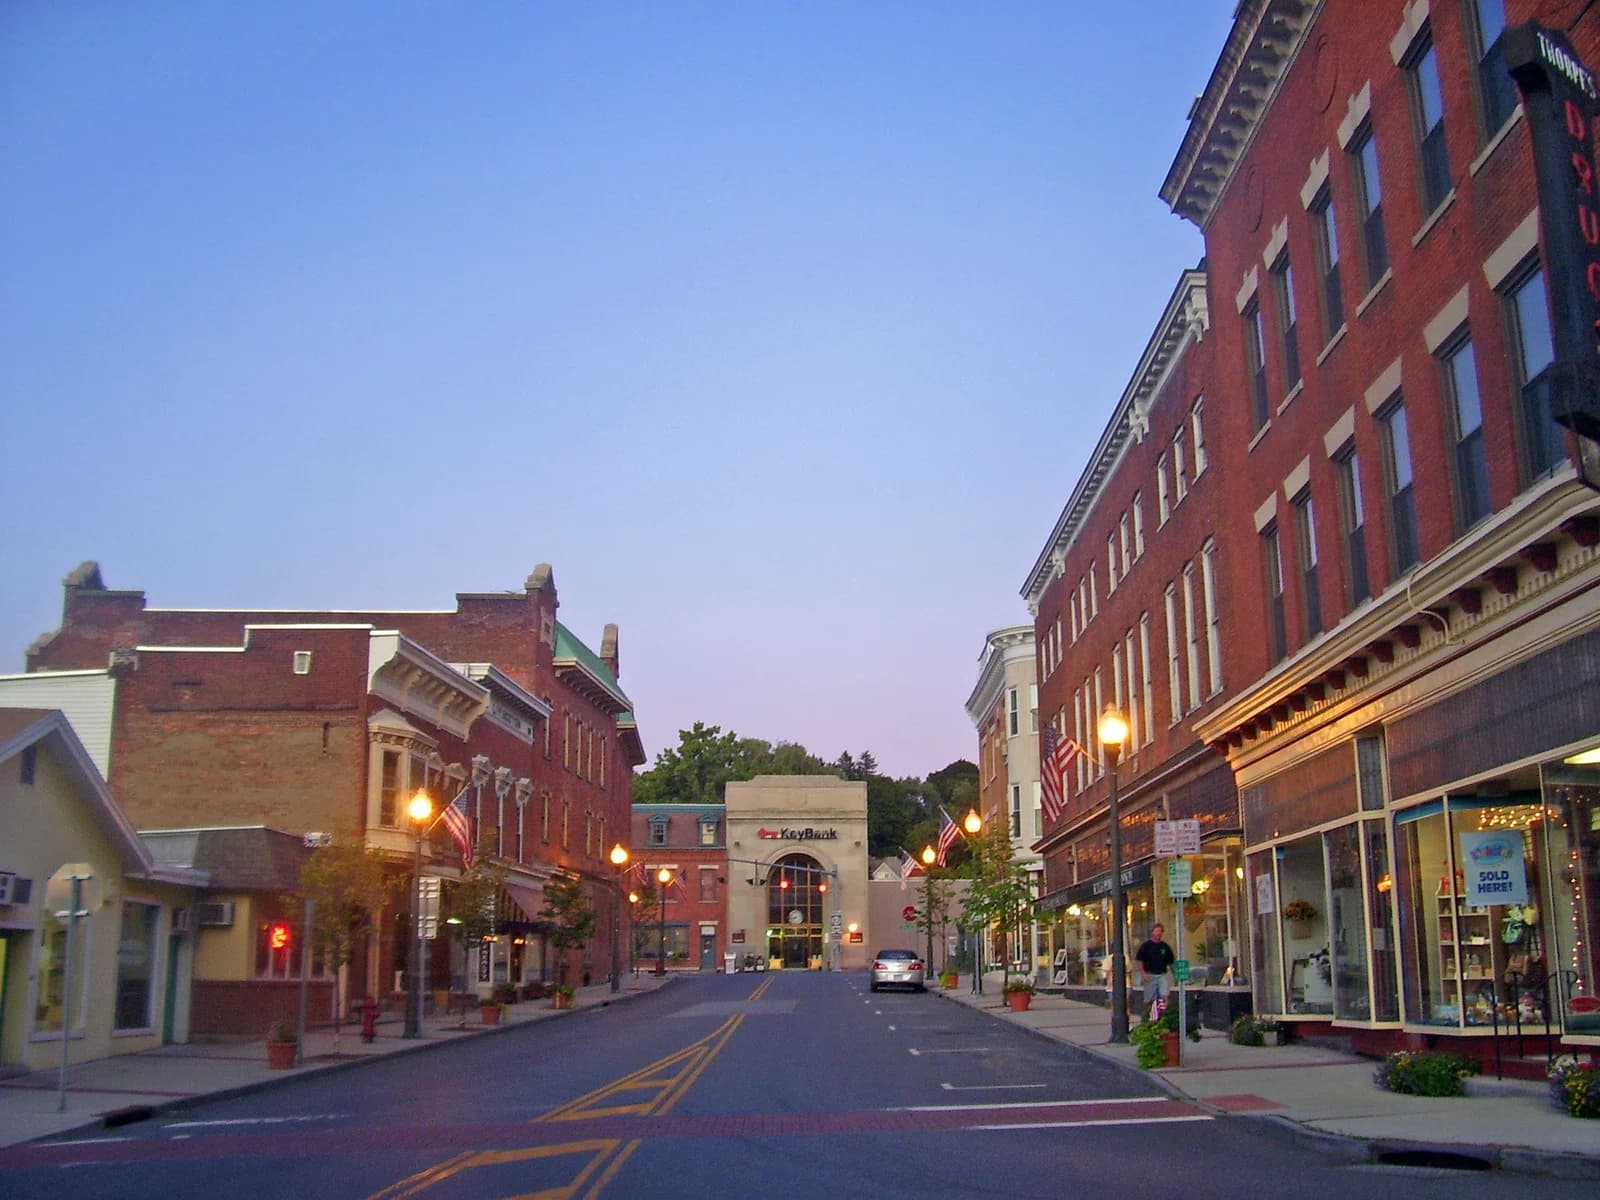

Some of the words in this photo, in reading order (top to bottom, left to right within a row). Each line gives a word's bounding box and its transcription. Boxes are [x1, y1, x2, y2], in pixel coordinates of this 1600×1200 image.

[1537, 31, 1597, 100] THORPE'S
[780, 827, 837, 841] KeyBank
[1479, 870, 1509, 881] SOLD
[1478, 882, 1512, 894] HERE!
